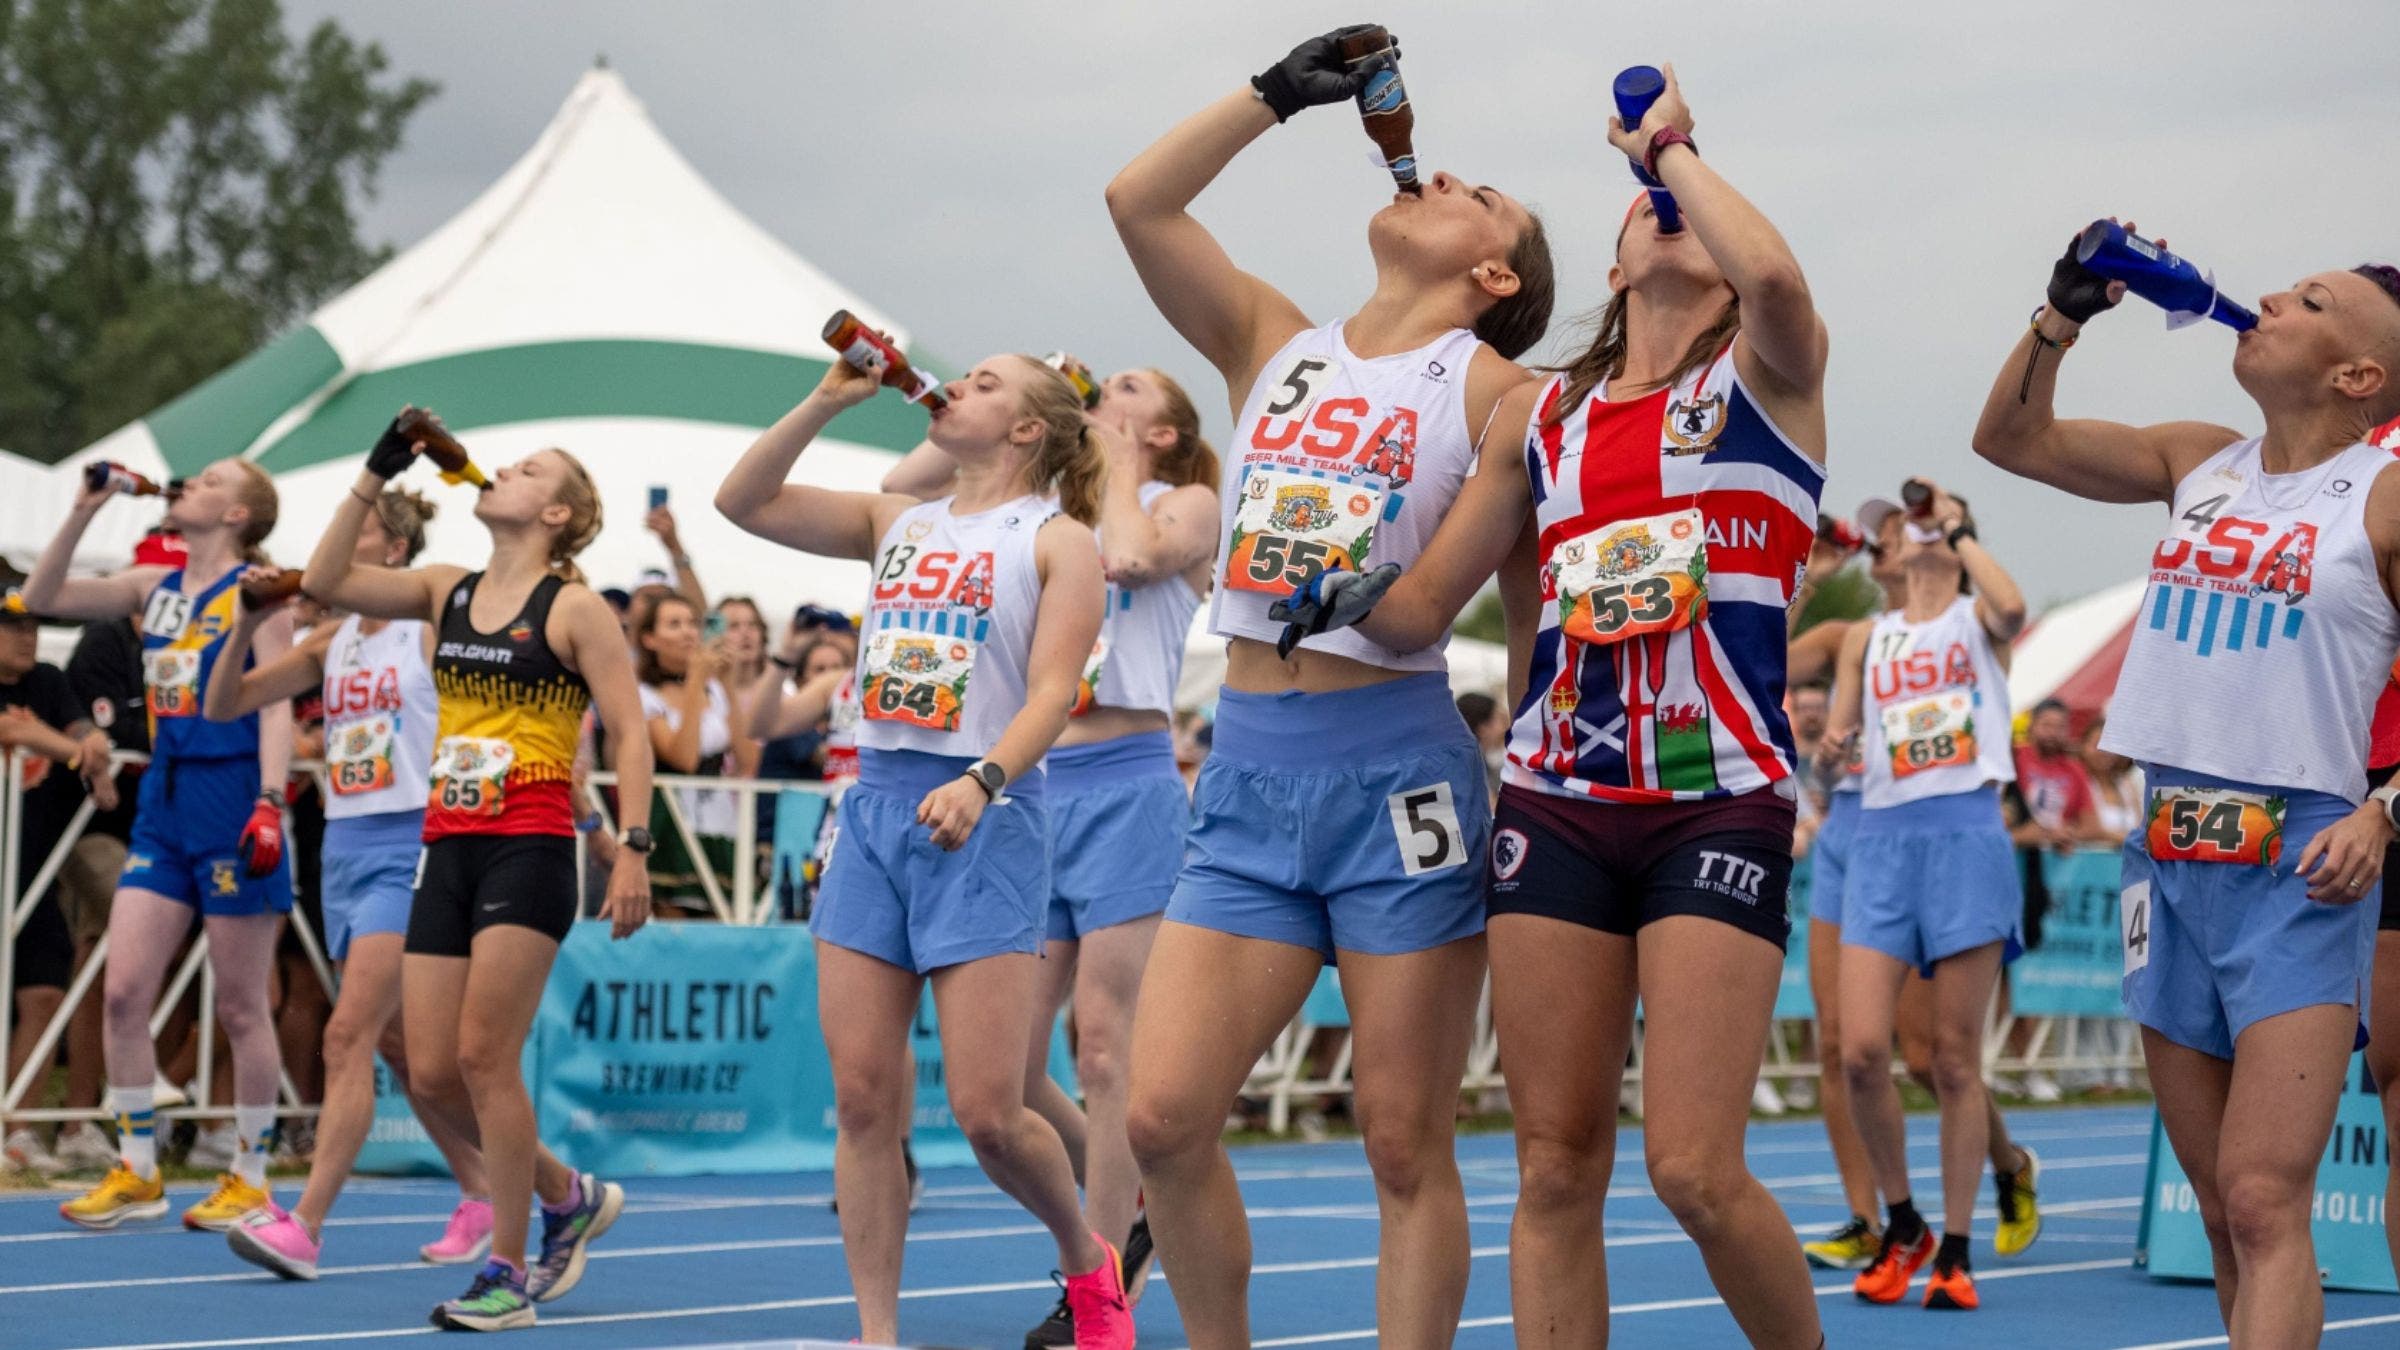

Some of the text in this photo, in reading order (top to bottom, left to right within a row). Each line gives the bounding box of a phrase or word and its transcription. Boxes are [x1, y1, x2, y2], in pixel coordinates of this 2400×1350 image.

[1266, 358, 1327, 416] 5
[1243, 452, 1351, 474] BEER MILE TEAM
[1250, 396, 1418, 483] USA
[2181, 493, 2231, 532] 4
[874, 551, 994, 608] USA
[879, 544, 917, 582] 13
[1248, 534, 1330, 589] 55
[2152, 515, 2319, 597] USA
[1589, 575, 1676, 636] 53
[2173, 575, 2204, 588] MILE
[2209, 580, 2248, 596] TEAM
[152, 596, 188, 633] 15
[1881, 632, 1908, 659] 17
[326, 667, 402, 716] USA
[1872, 642, 1978, 700] USA
[155, 686, 180, 711] 66
[878, 677, 937, 719] 64
[341, 758, 375, 787] 63
[1908, 733, 1956, 767] 68
[441, 778, 482, 811] 65
[1404, 791, 1450, 869] 5
[2169, 799, 2246, 853] 54
[1698, 850, 1765, 897] TTR
[2128, 900, 2148, 956] 4
[572, 980, 776, 1042] ATHLETIC
